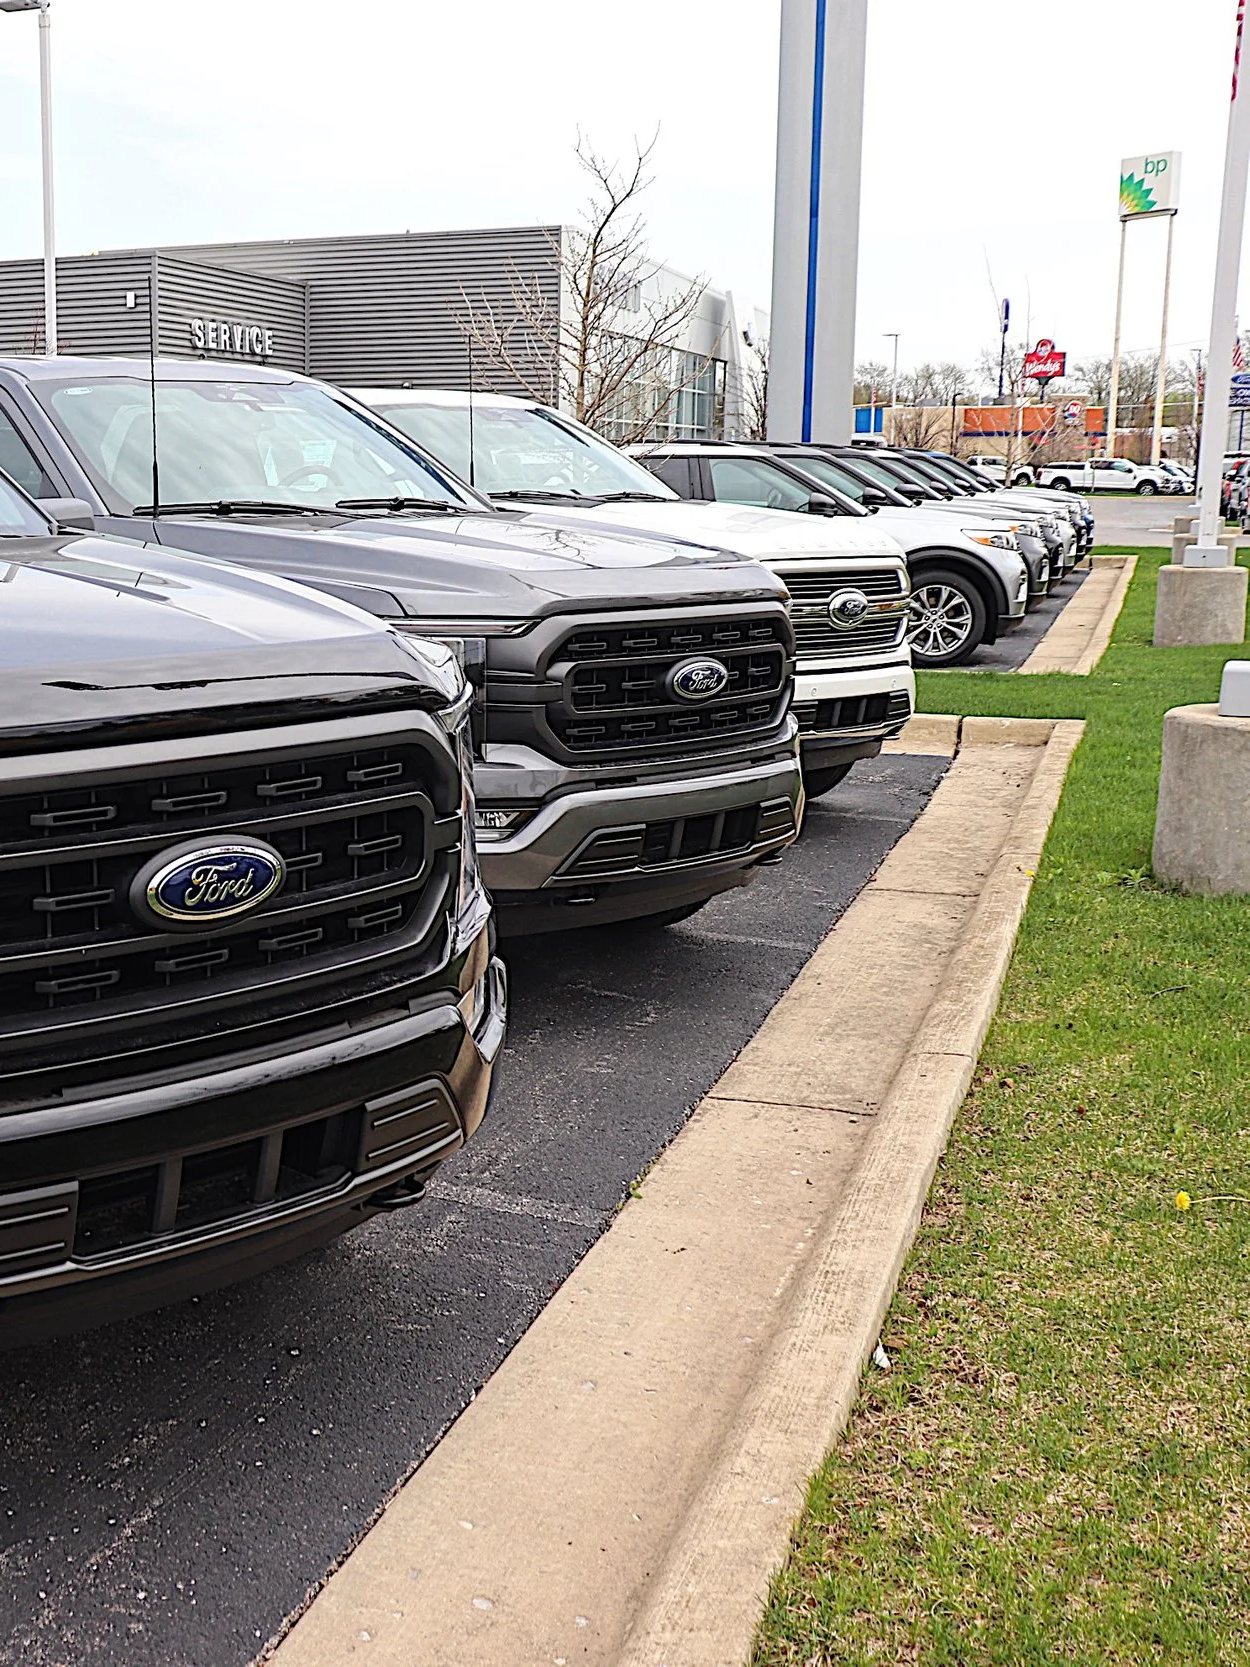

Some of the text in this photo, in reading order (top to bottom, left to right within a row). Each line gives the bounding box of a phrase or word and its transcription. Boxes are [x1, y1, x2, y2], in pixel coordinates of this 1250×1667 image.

[1144, 157, 1168, 177] bp
[191, 318, 273, 355] SERVICE
[843, 600, 863, 615] Ford
[688, 669, 719, 691] Ford
[184, 862, 254, 906] Ford
